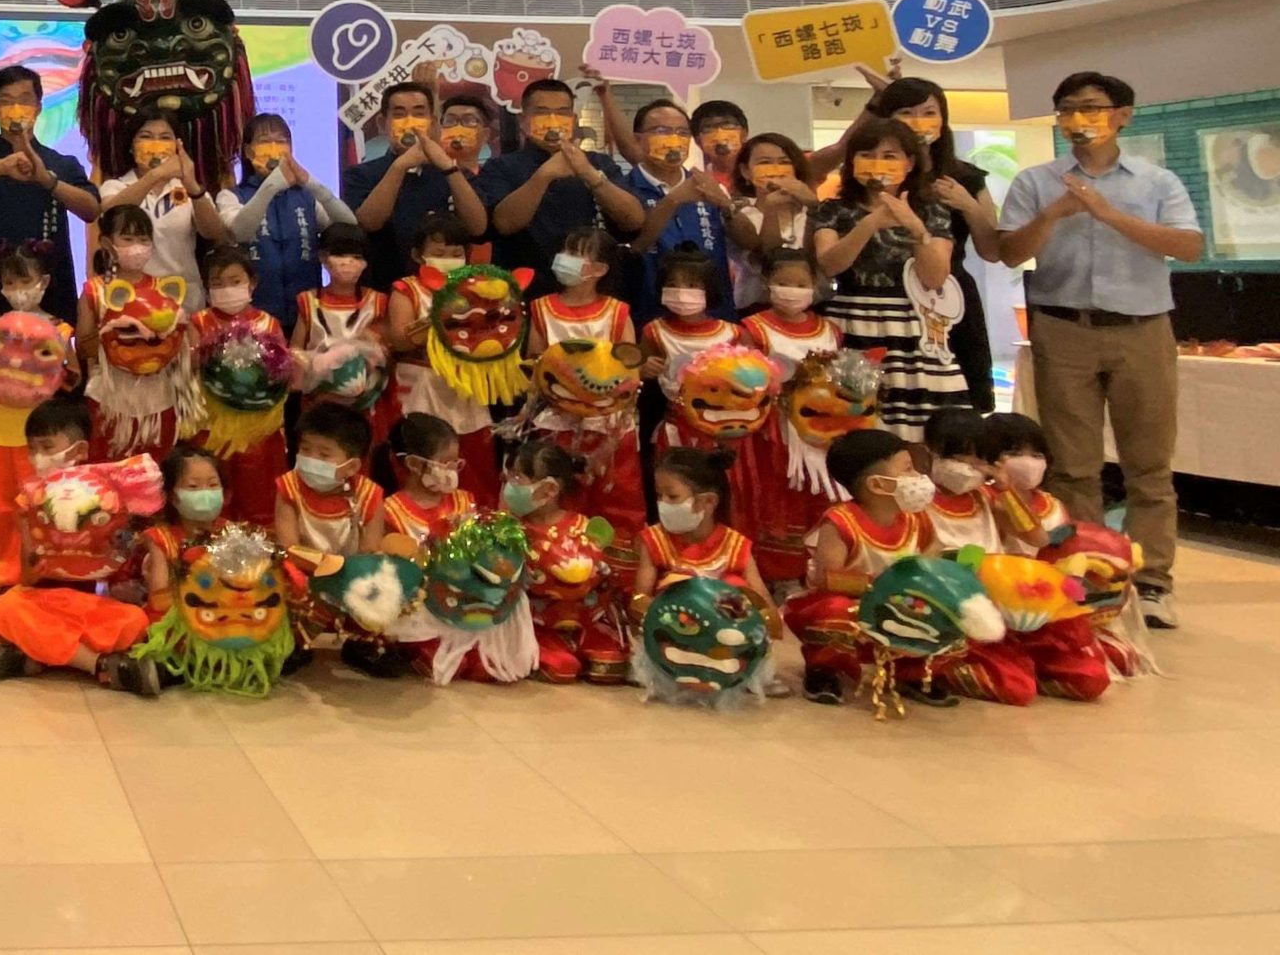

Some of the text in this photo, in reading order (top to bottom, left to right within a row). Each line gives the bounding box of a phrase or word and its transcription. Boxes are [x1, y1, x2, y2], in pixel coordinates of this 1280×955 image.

[923, 14, 960, 33] VS
[611, 27, 697, 51] 西螺七崁
[800, 38, 847, 62] 路跑
[598, 44, 708, 70] 武術大會師
